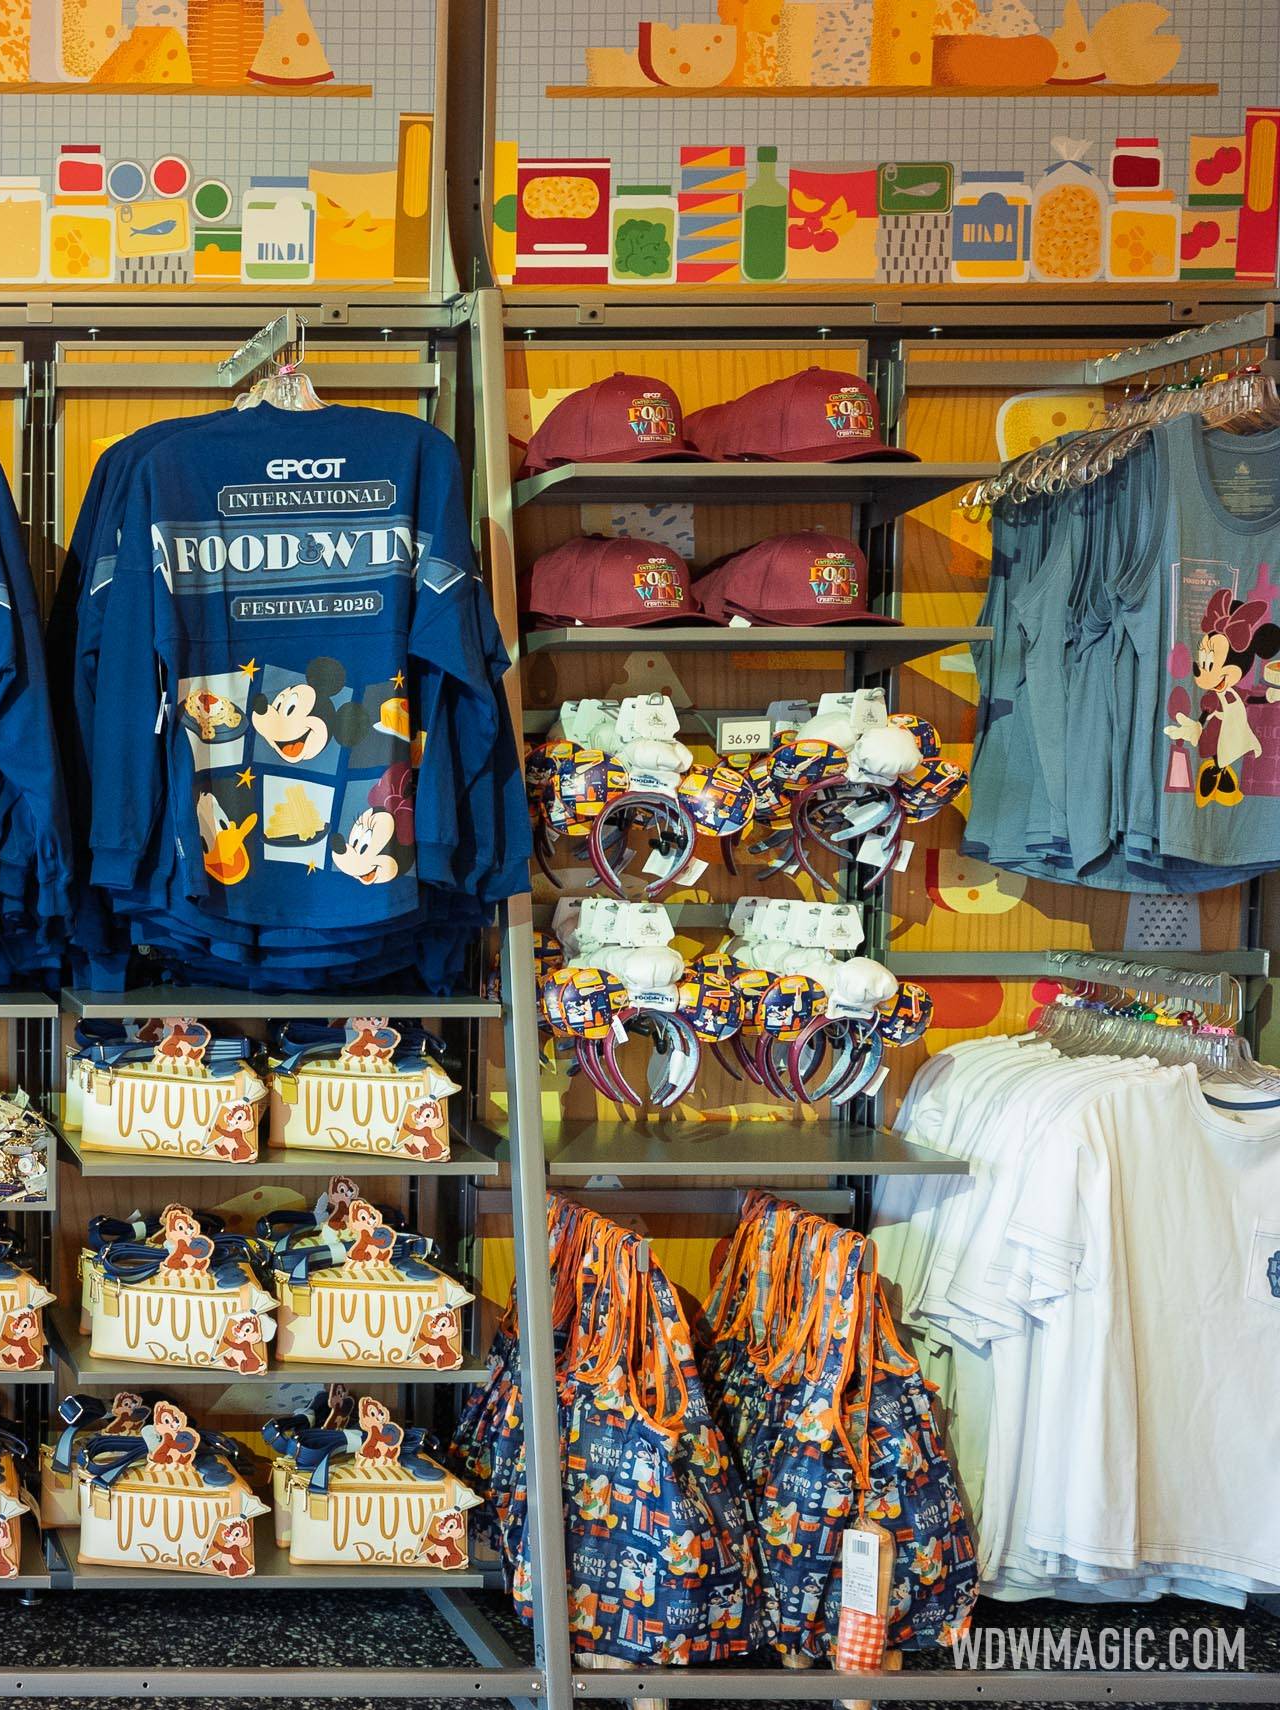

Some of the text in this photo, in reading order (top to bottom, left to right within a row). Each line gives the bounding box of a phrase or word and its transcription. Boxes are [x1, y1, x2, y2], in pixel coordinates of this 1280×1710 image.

[627, 406, 673, 421] FOOD
[825, 401, 872, 417] FOOD
[628, 421, 676, 436] WINE
[826, 416, 874, 430] WINE
[267, 458, 346, 480] EPCOT
[228, 488, 385, 508] INTERNATIONAL
[174, 526, 425, 577] FOOD & WIN
[632, 571, 680, 587] FOOD
[809, 567, 857, 584] FOOD
[634, 586, 684, 600] WINE
[810, 582, 858, 597] WINE
[240, 598, 374, 616] FESTIVAL 2026
[728, 734, 760, 745] 36.99
[136, 1129, 202, 1154] Dale
[326, 1127, 391, 1154] Dale
[145, 1340, 210, 1365] Dale
[338, 1338, 404, 1364] Dale
[137, 1542, 201, 1568] Dale
[353, 1541, 415, 1565] Dale
[573, 1553, 606, 1568] FOOD
[573, 1563, 606, 1578] WINE
[667, 1606, 700, 1617] FOOD
[667, 1615, 699, 1626] WINE
